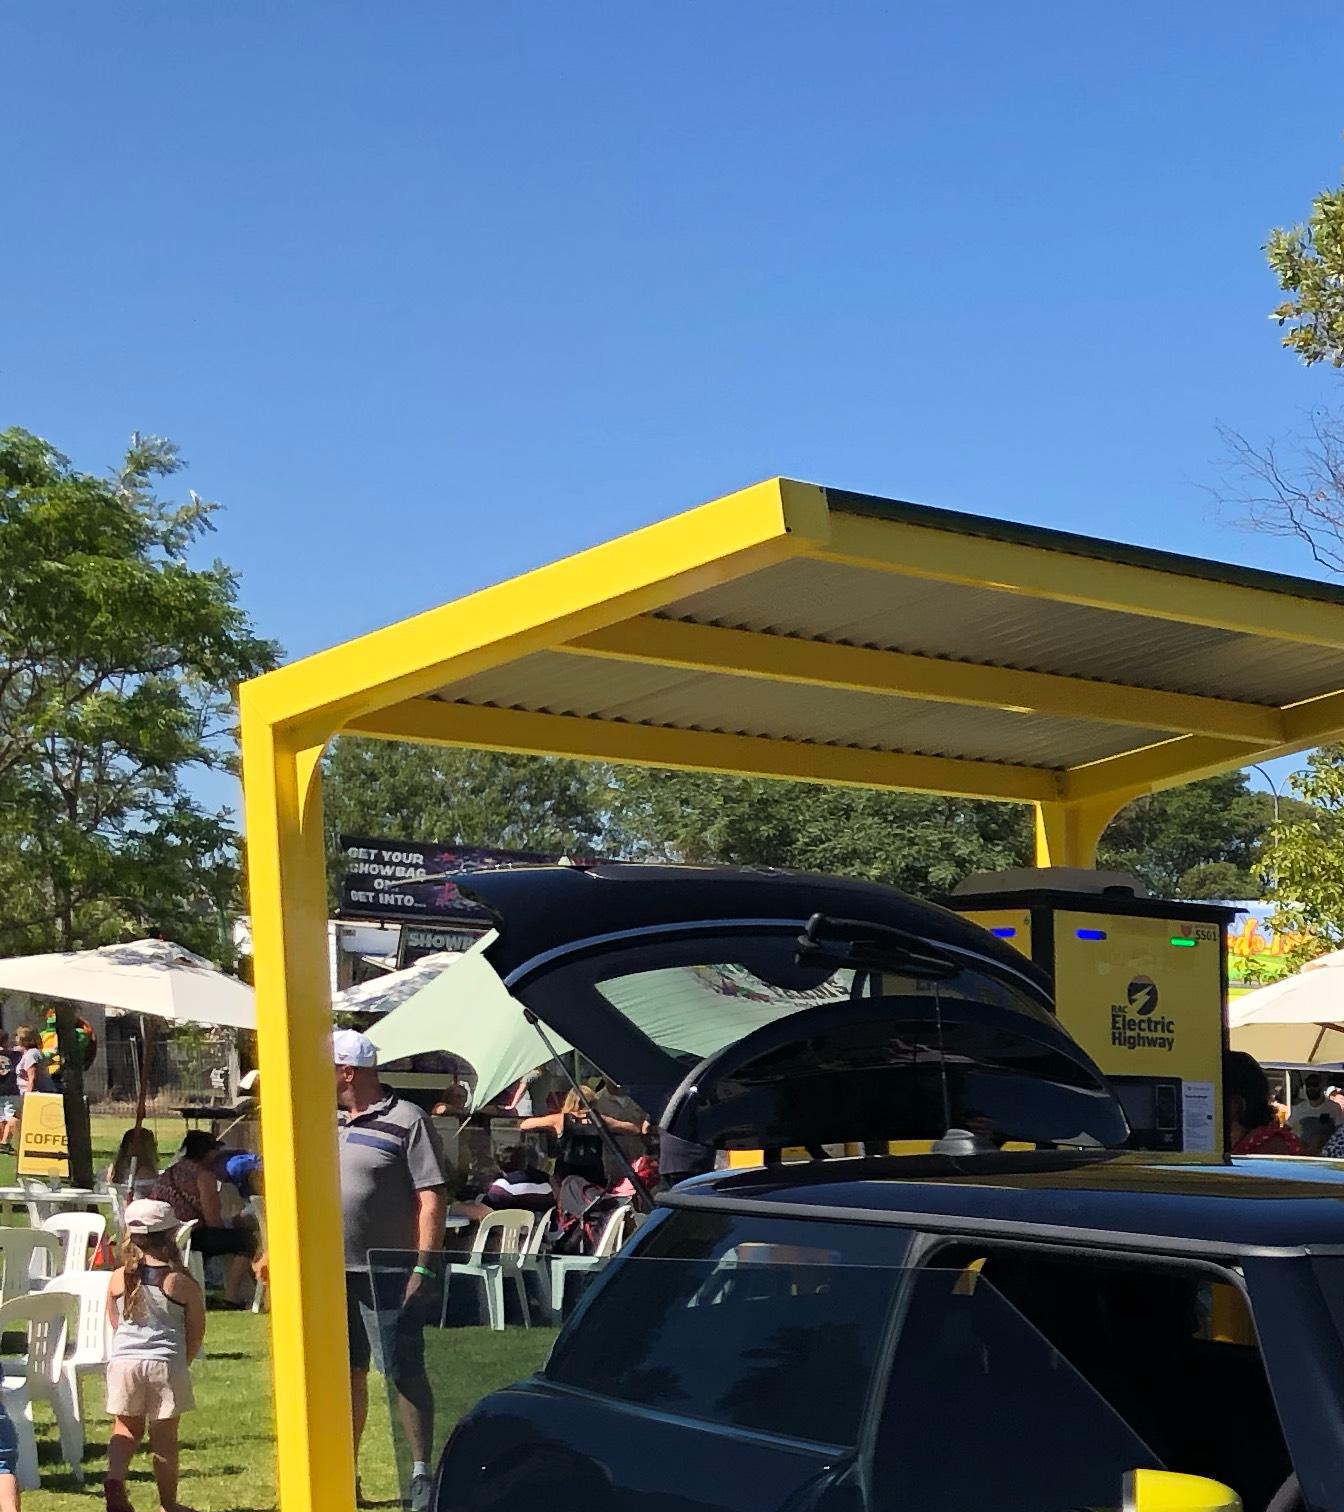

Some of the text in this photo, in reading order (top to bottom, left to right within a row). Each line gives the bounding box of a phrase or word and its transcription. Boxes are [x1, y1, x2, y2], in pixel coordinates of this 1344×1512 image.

[348, 847, 424, 865] GET YOUR
[351, 890, 375, 903] GET
[1111, 1004, 1128, 1014] RAC
[1111, 1014, 1175, 1034] Electric
[1111, 1030, 1175, 1052] Highway
[25, 1132, 69, 1147] COFFE
